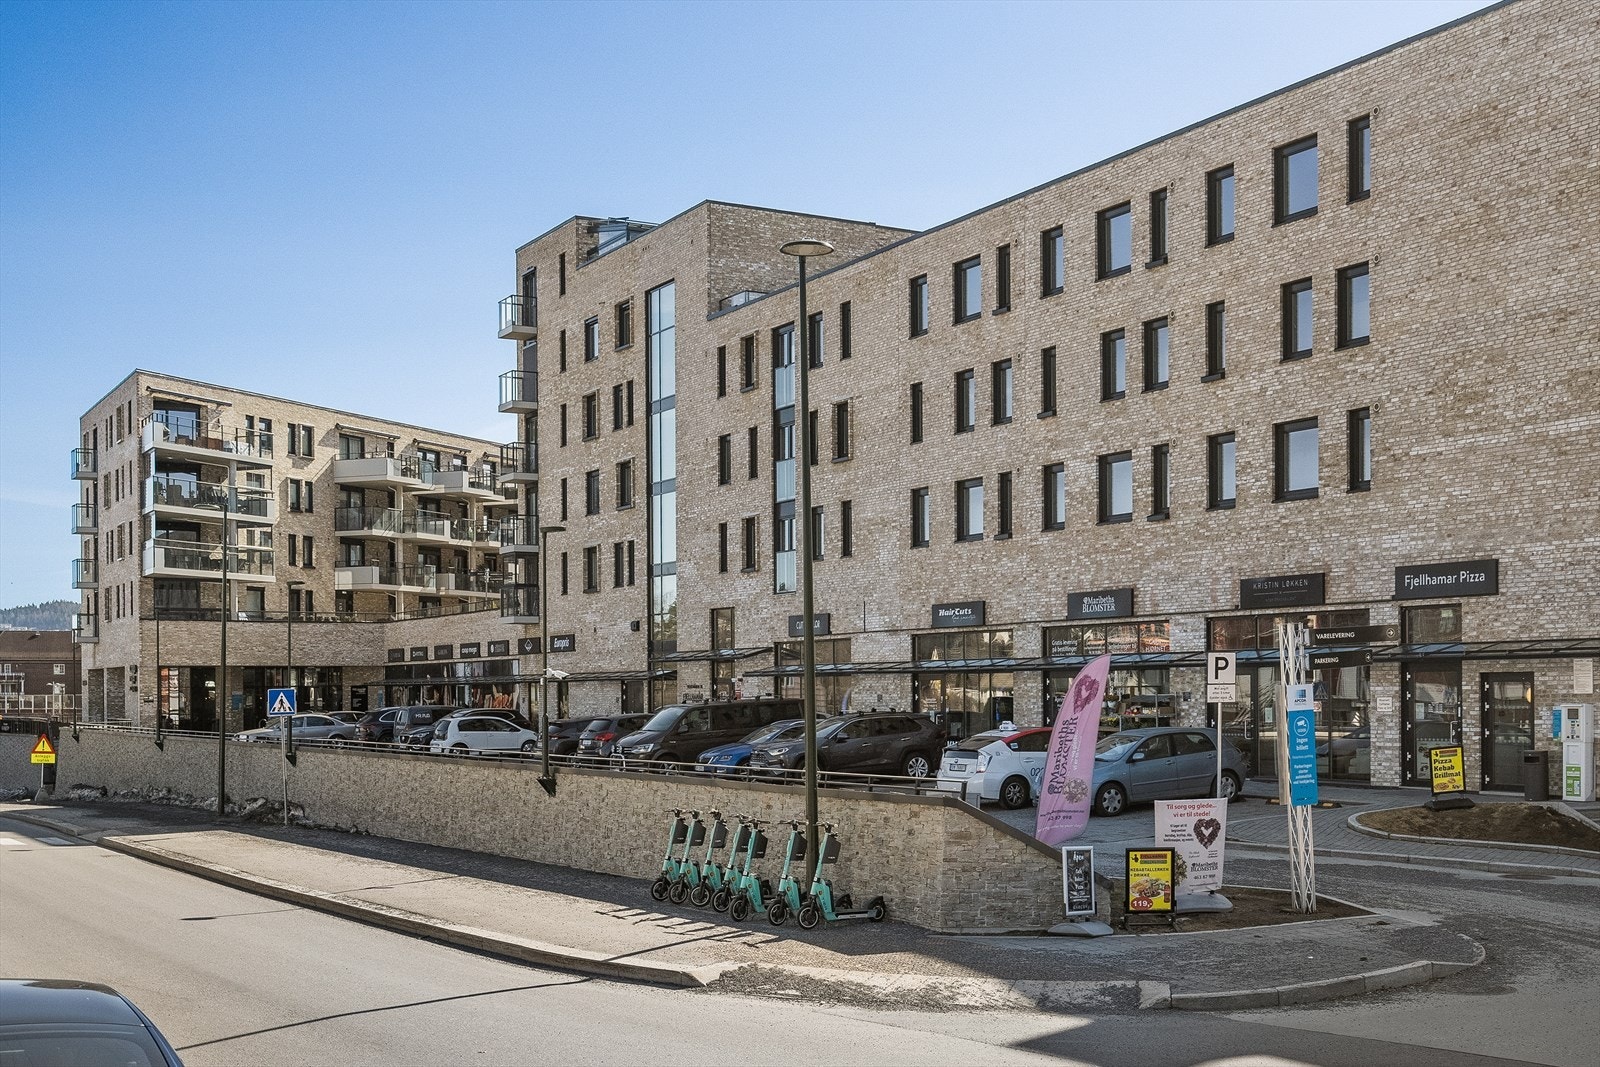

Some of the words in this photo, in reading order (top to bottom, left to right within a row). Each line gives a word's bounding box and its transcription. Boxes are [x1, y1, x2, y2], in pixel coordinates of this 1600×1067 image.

[1252, 581, 1279, 590] KRISTIN
[1281, 579, 1309, 588] LØKKEN
[1404, 573, 1457, 590] Fjellhamar
[1460, 570, 1486, 583] Pizza
[1087, 595, 1115, 603] Maribeths
[1082, 602, 1116, 613] BLOMSTER
[1316, 631, 1355, 640] VARELEVERING
[553, 637, 570, 650] Europris
[1314, 656, 1339, 664] PARKERING
[1214, 656, 1229, 680] P
[1049, 720, 1070, 784] Maribeths
[1434, 771, 1461, 779] Grillmat
[1174, 803, 1187, 811] sorg
